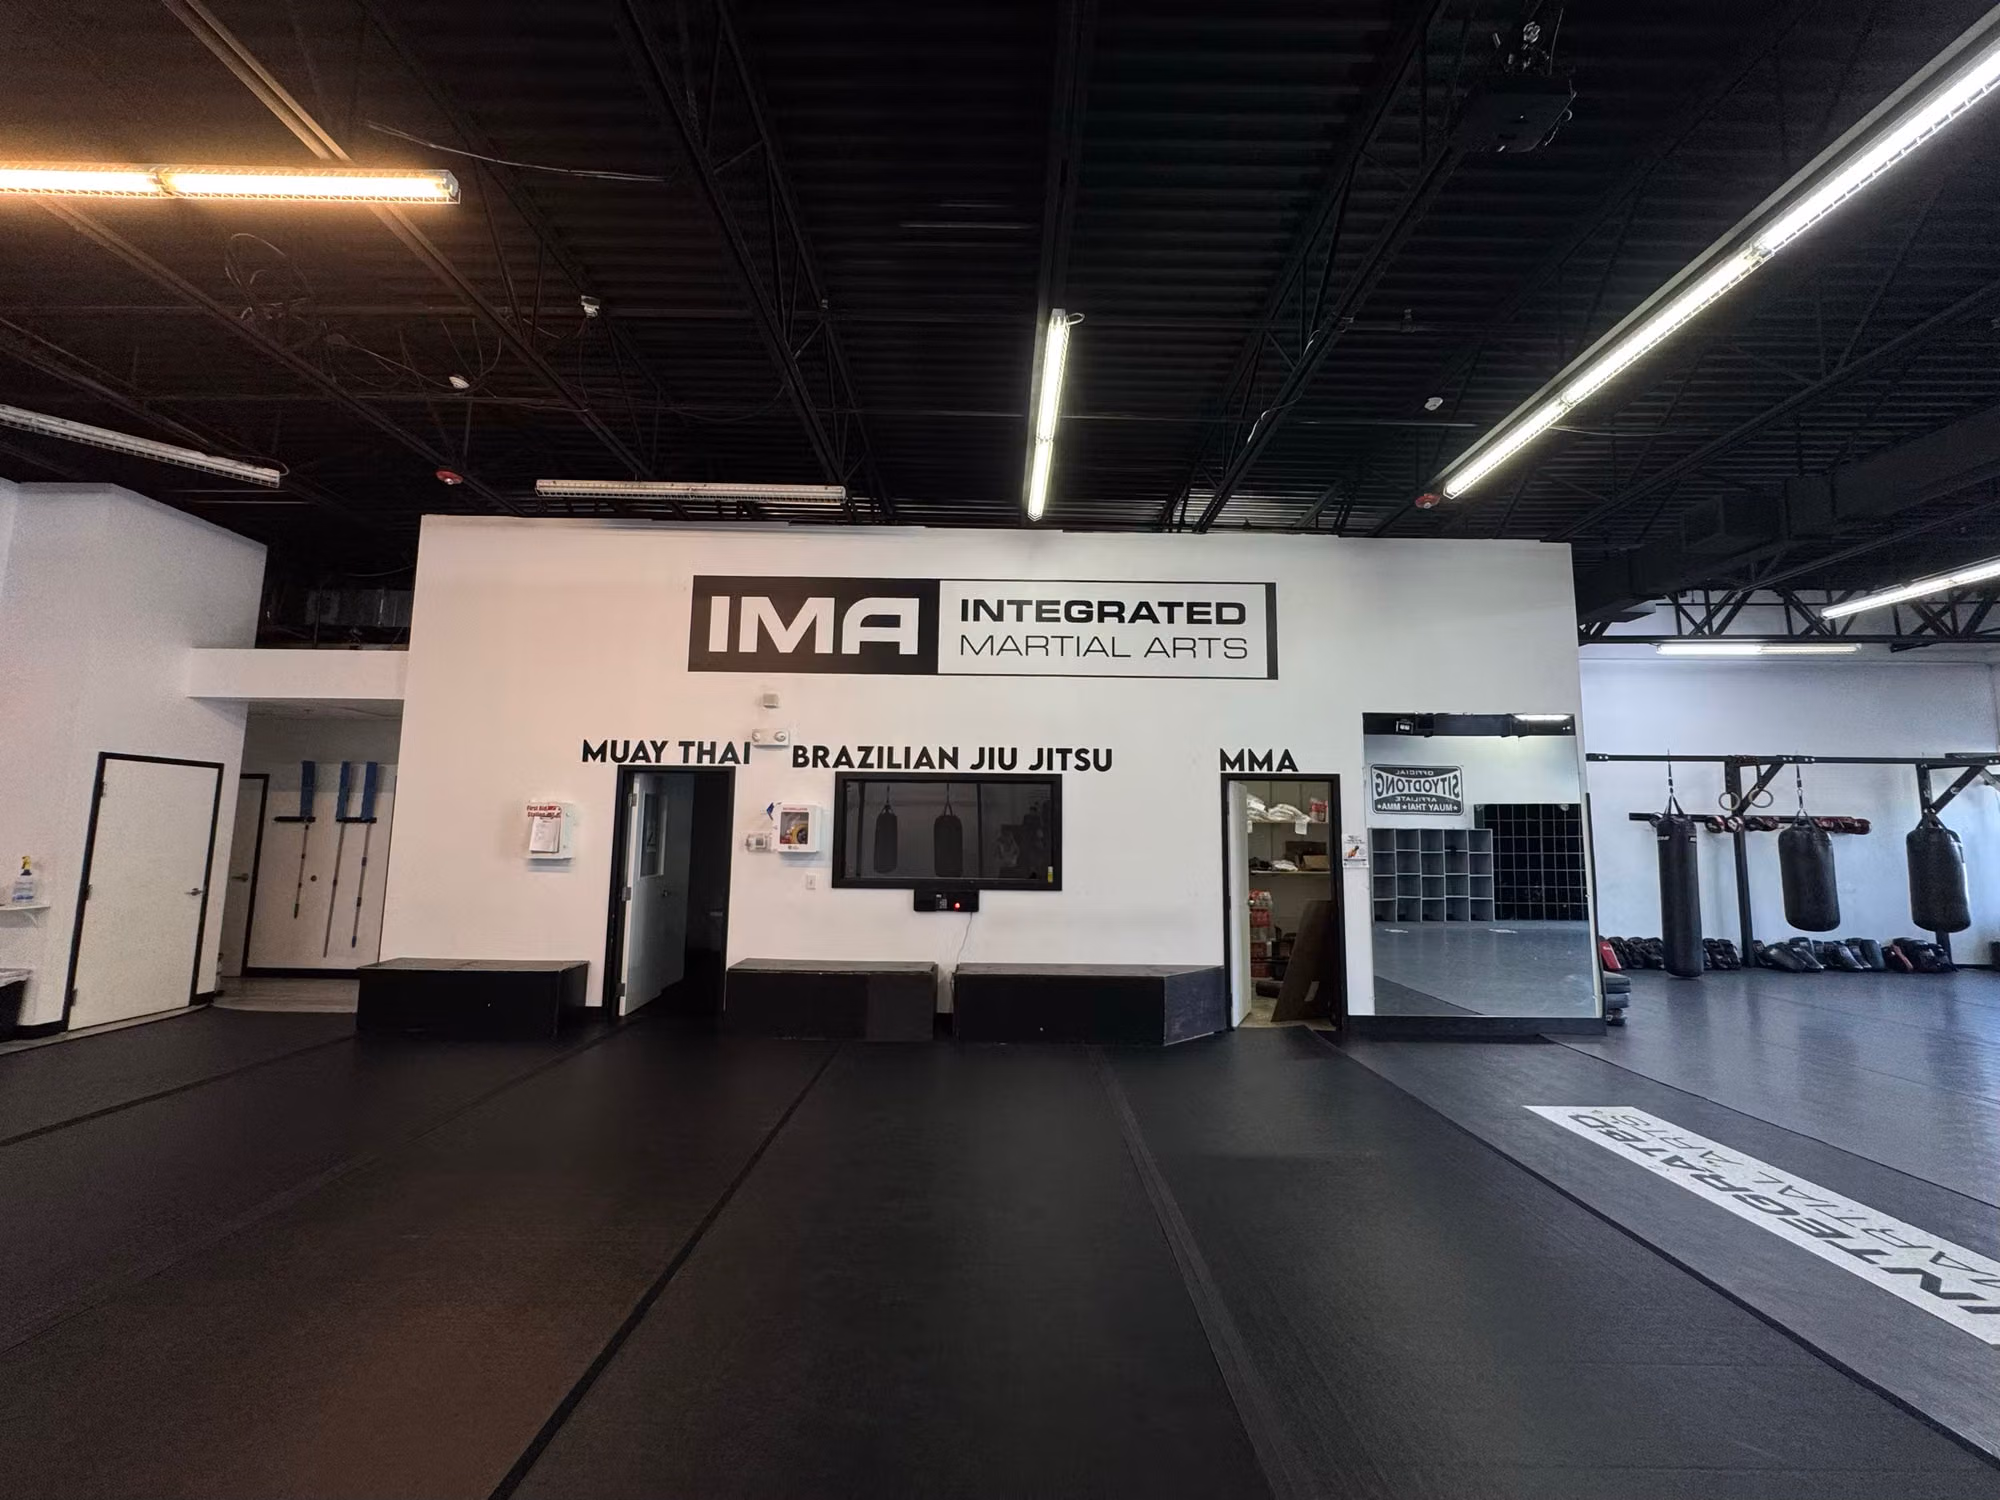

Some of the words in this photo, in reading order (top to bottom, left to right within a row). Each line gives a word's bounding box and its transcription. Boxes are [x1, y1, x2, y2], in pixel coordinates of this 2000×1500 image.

[961, 599, 1246, 625] INTEGRATED
[709, 596, 919, 655] IMA
[960, 635, 1132, 658] MARTIAL
[1144, 636, 1248, 659] ARTS
[582, 740, 668, 764] MUAY
[678, 741, 751, 765] THAI
[792, 745, 959, 770] BRAZILIAN
[969, 747, 1018, 771] JIU
[1028, 748, 1113, 773] JITSU
[1220, 748, 1299, 773] MMA
